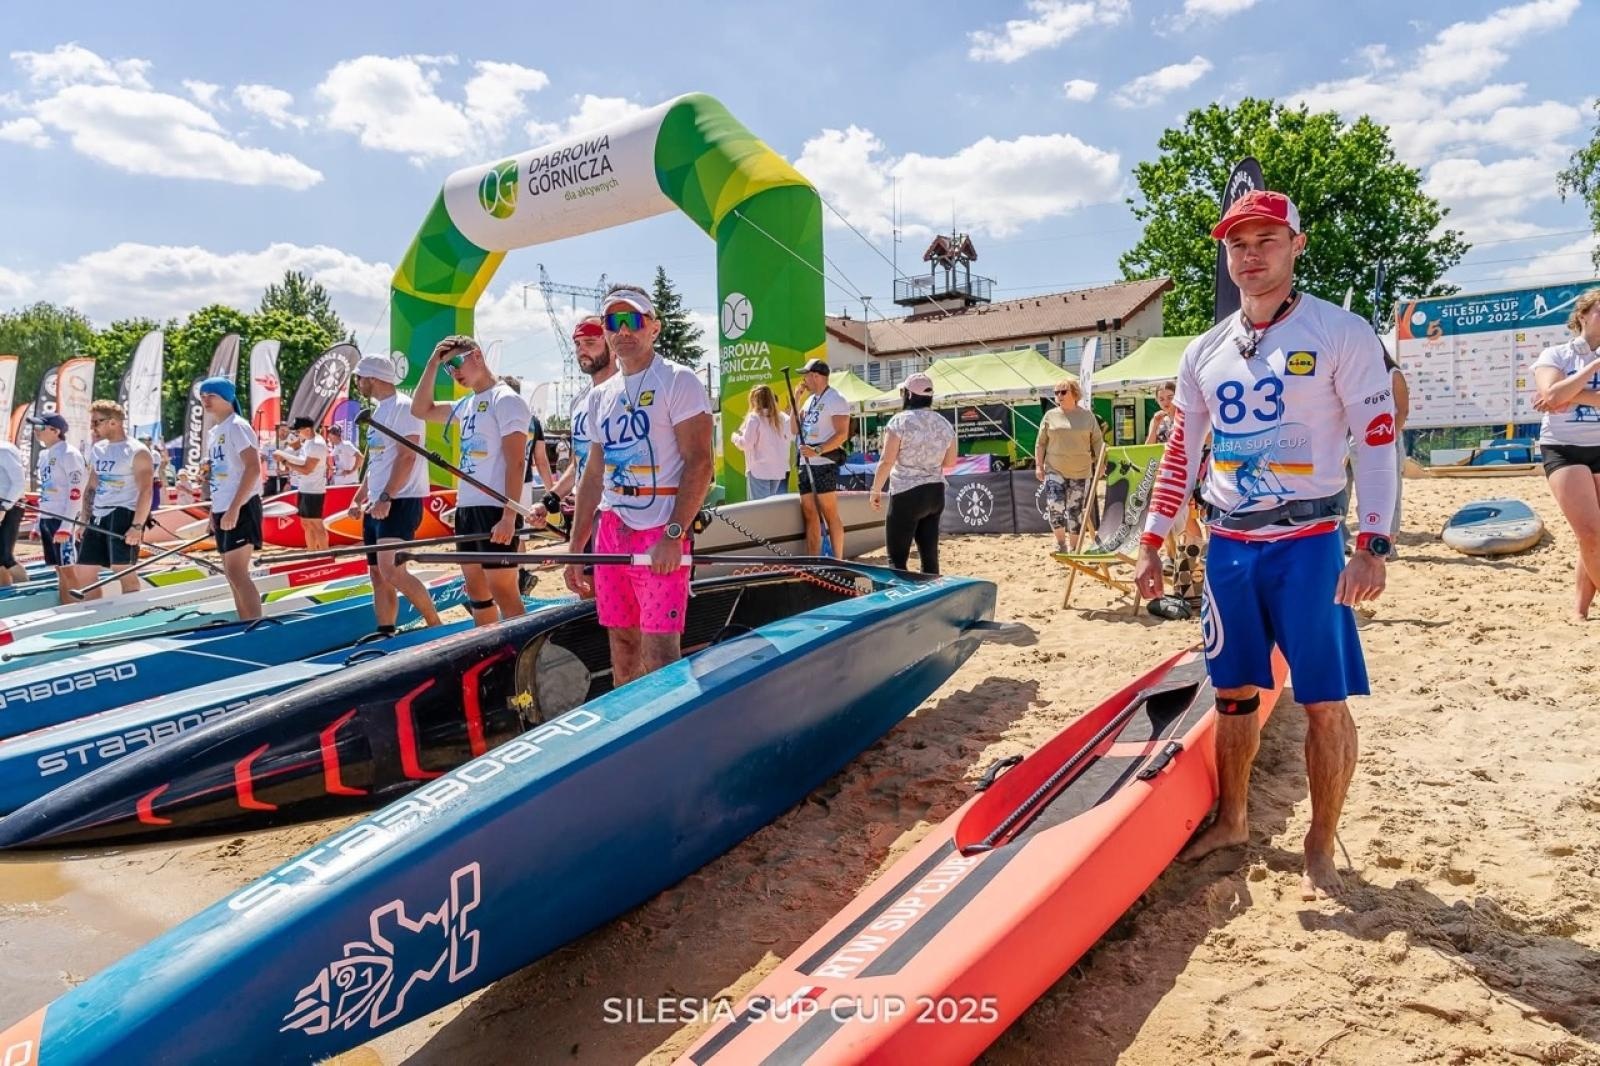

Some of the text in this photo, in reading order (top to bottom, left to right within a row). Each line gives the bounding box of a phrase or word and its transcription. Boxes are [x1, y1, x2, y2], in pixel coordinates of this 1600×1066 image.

[529, 135, 610, 174] DĄBROWA
[528, 154, 613, 196] GÓRNICZA
[1441, 304, 1488, 318] SILESIA
[1493, 301, 1519, 312] SUP
[1456, 313, 1519, 326] CUP 2025
[1216, 377, 1285, 424] 83
[1364, 389, 1390, 405] GURU
[601, 409, 650, 446] 120
[1278, 437, 1307, 450] CUP
[96, 460, 116, 472] 127
[963, 514, 989, 526] GURU
[813, 855, 977, 979] RTW SUP CLUB
